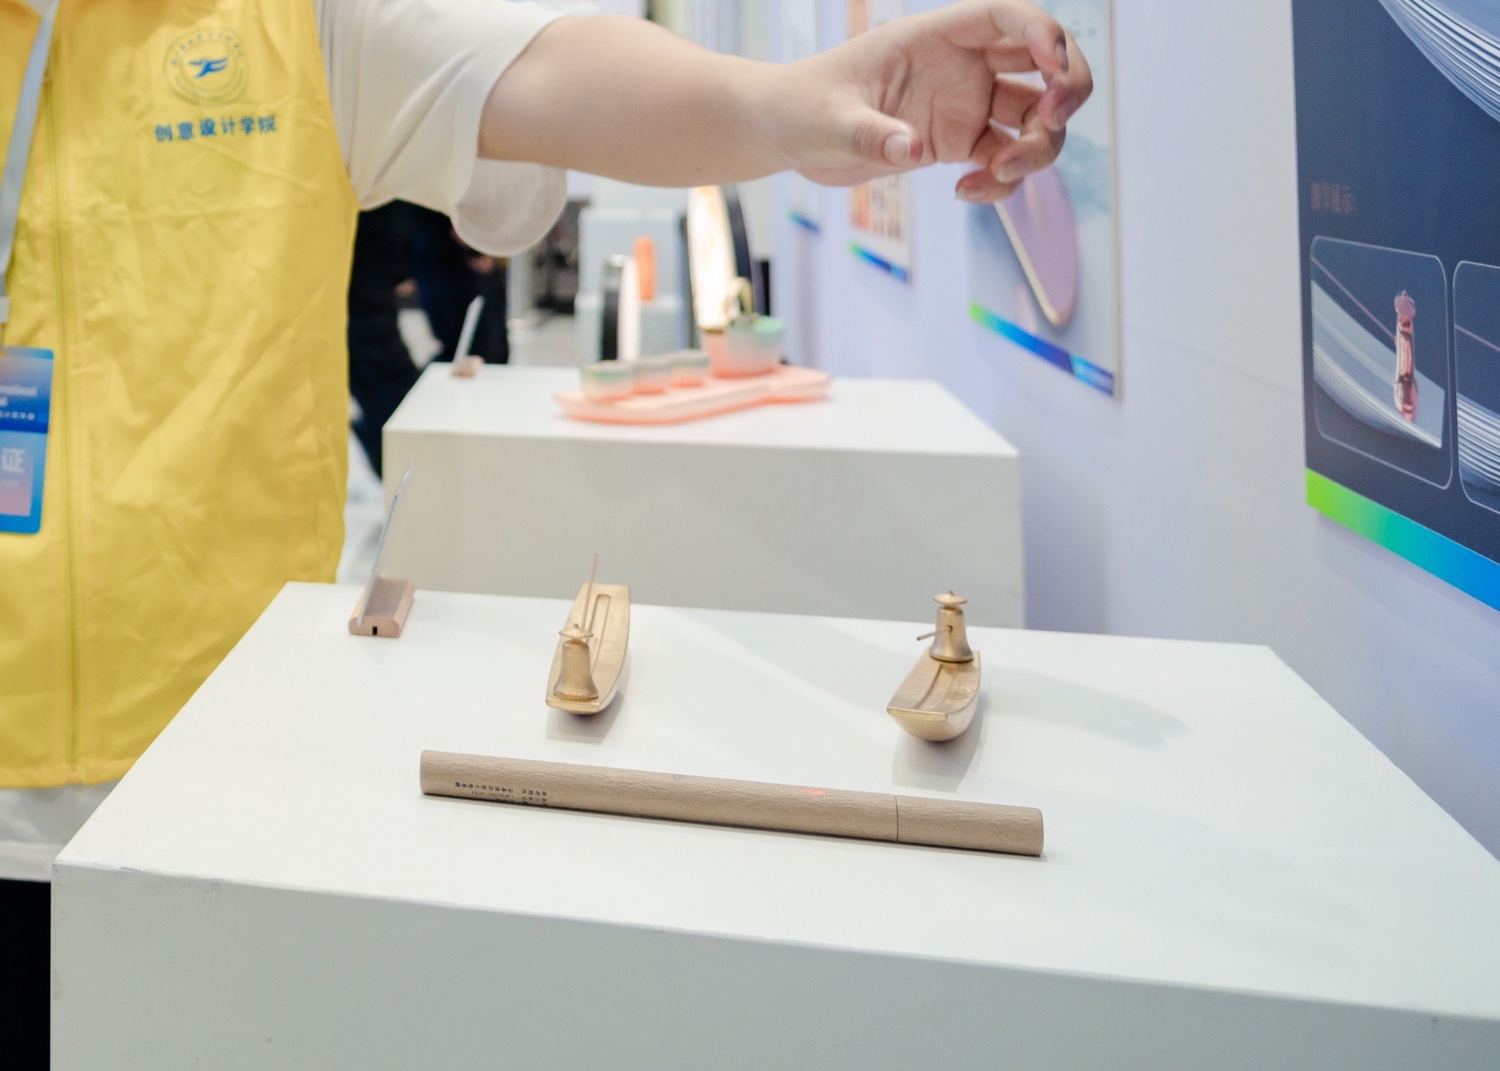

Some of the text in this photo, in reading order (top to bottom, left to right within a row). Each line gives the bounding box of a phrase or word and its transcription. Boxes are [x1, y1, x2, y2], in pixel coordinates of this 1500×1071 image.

[155, 114, 277, 143] 创意设计学院
